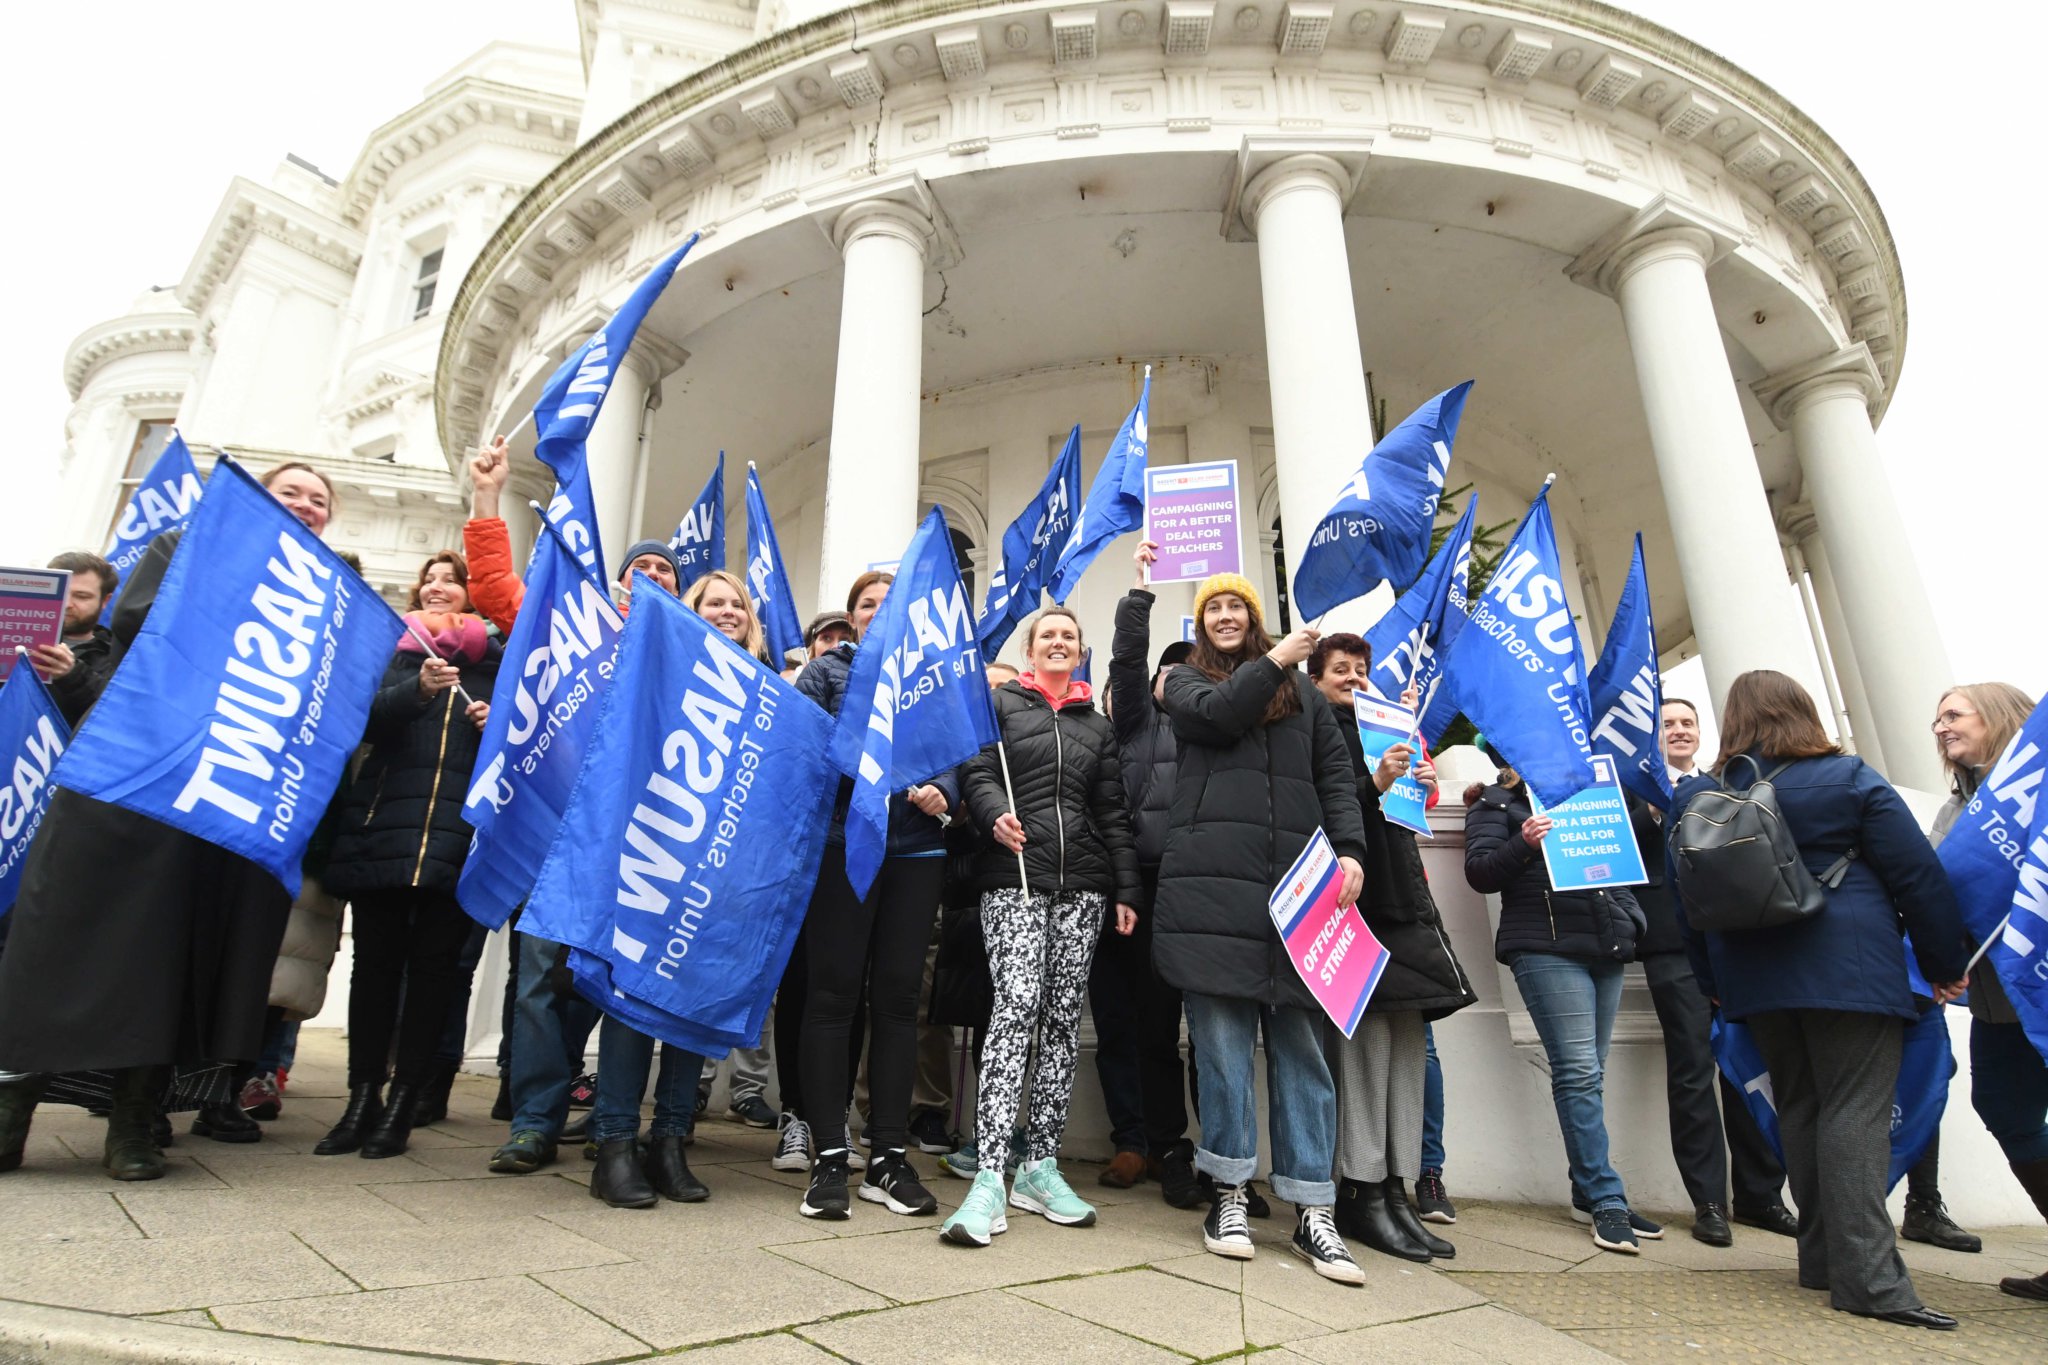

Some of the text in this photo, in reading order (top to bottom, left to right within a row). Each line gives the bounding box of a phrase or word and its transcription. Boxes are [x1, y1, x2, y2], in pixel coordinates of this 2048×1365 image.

[1151, 501, 1233, 516] CAMPAIGNING
[1154, 515, 1232, 529] FOR A BETTER
[1165, 529, 1221, 542] DEAL FOR
[1164, 542, 1224, 555] TEACHERS
[2, 634, 34, 643] FOR
[1551, 813, 1623, 829] OR A BETTER
[1560, 829, 1615, 842] DEAL FOR
[1561, 844, 1621, 858] TEACHERS
[1320, 922, 1357, 987] STRIKE
